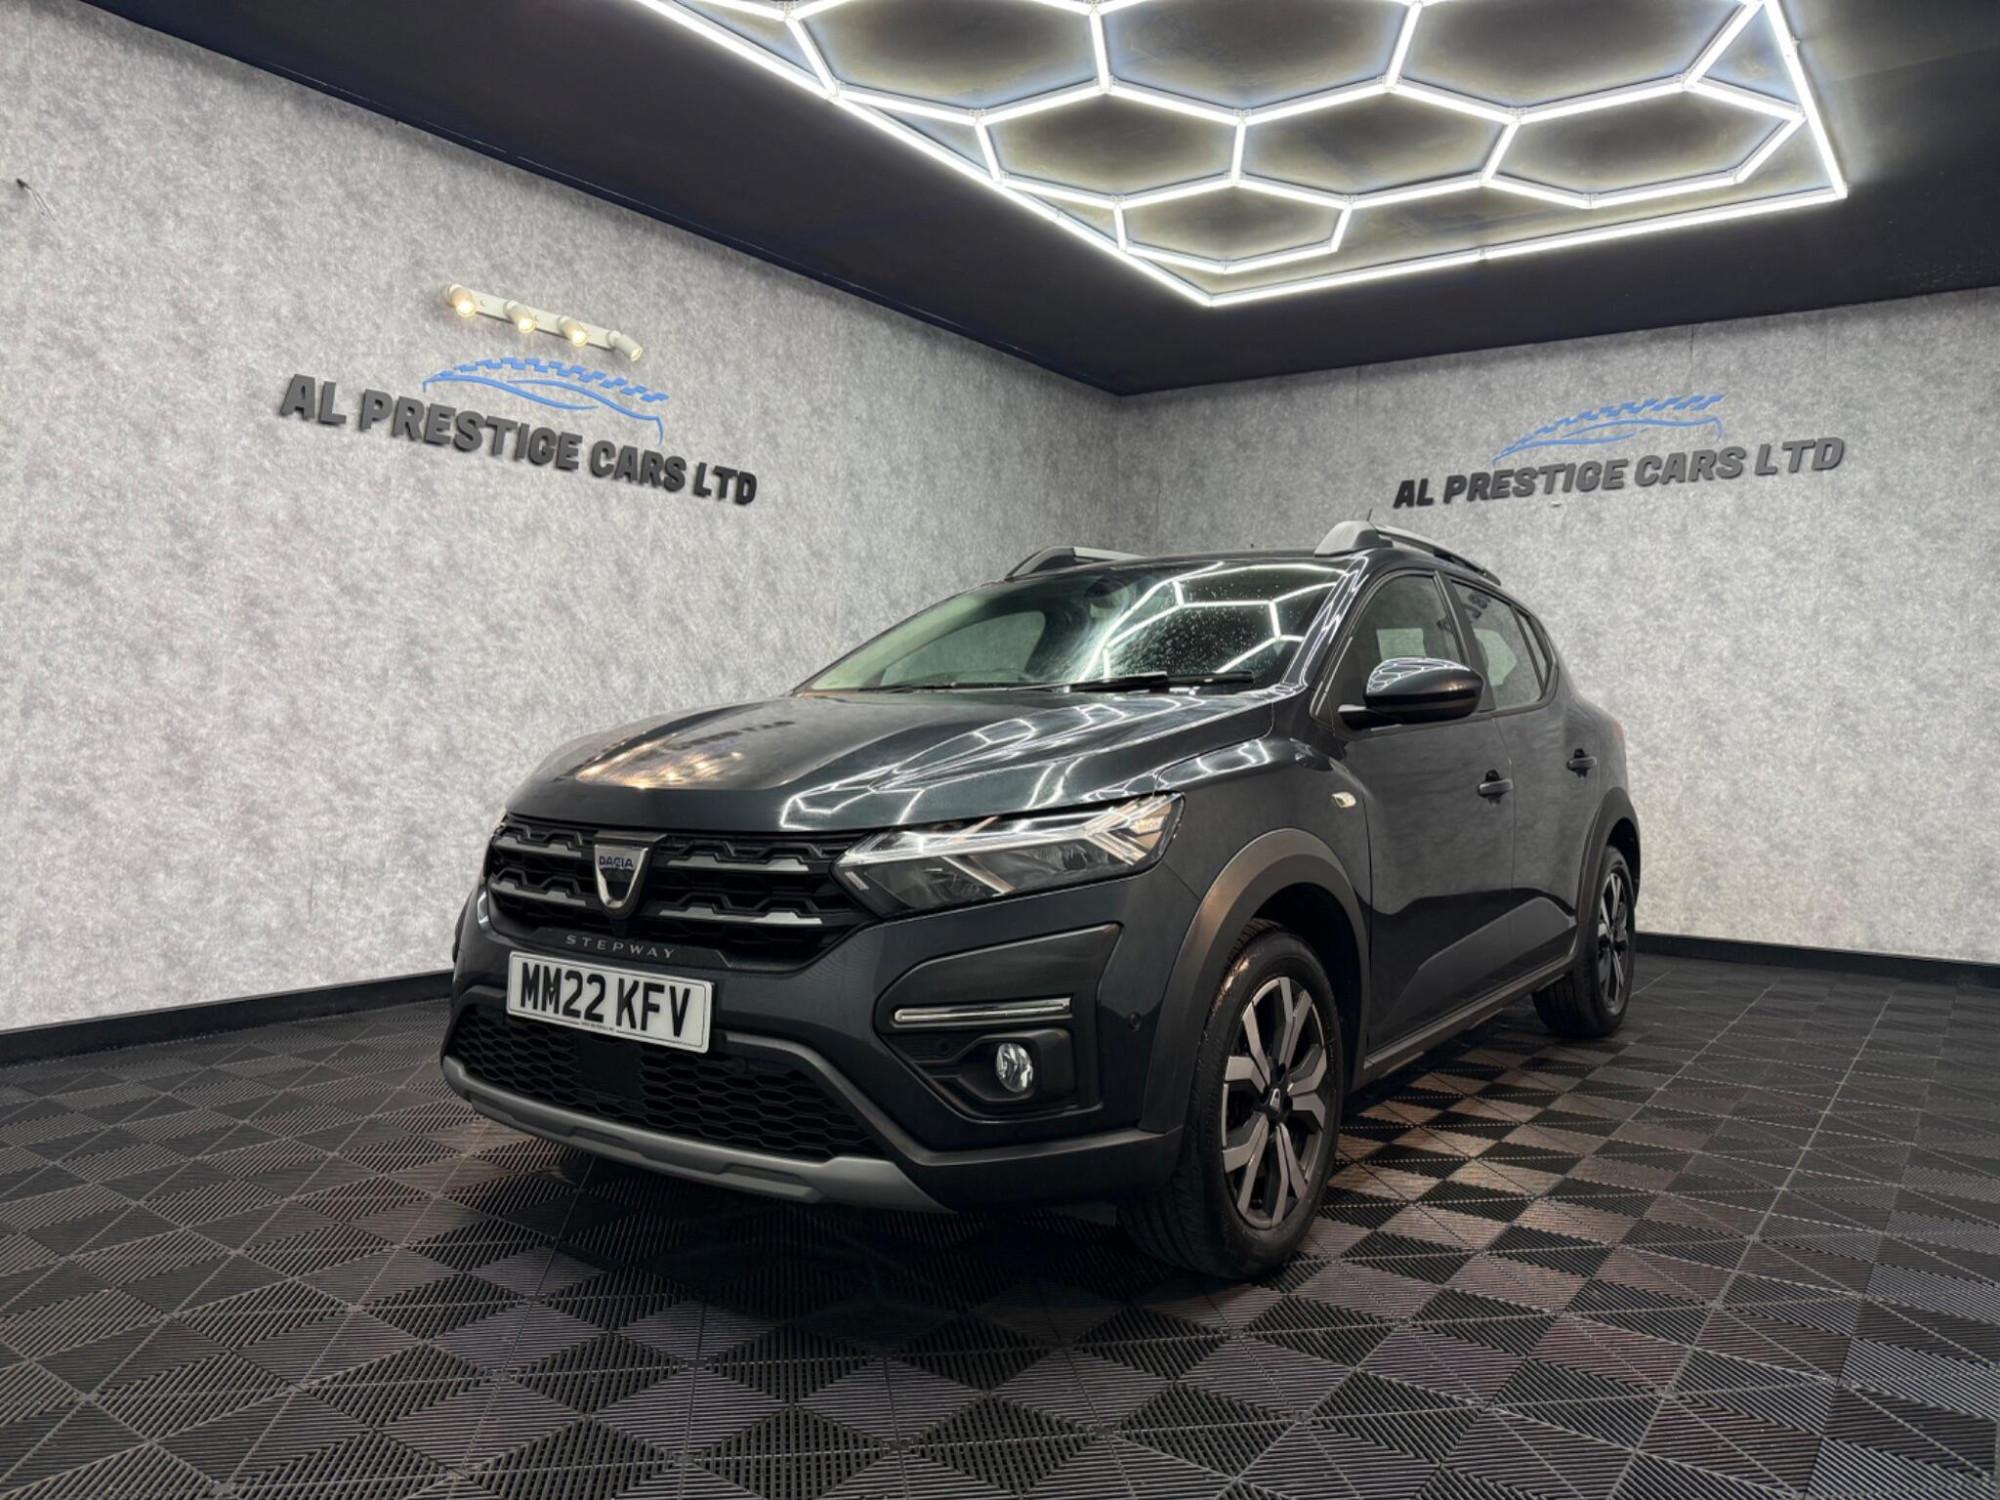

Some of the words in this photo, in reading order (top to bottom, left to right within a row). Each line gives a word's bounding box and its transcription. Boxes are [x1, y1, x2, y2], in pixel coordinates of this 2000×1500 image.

[279, 373, 347, 427] AL
[359, 388, 584, 471] PRESTIGE
[590, 440, 687, 493] CARS
[692, 461, 758, 506] LTD
[1393, 478, 1434, 509] AL
[1443, 458, 1631, 505] PRESTIGE
[1634, 446, 1747, 488] CARS
[1754, 436, 1845, 477] LTD
[598, 855, 634, 870] DACIA
[565, 934, 675, 959] STEPWAY
[519, 961, 607, 1024] MM22
[615, 976, 691, 1038] KFV
